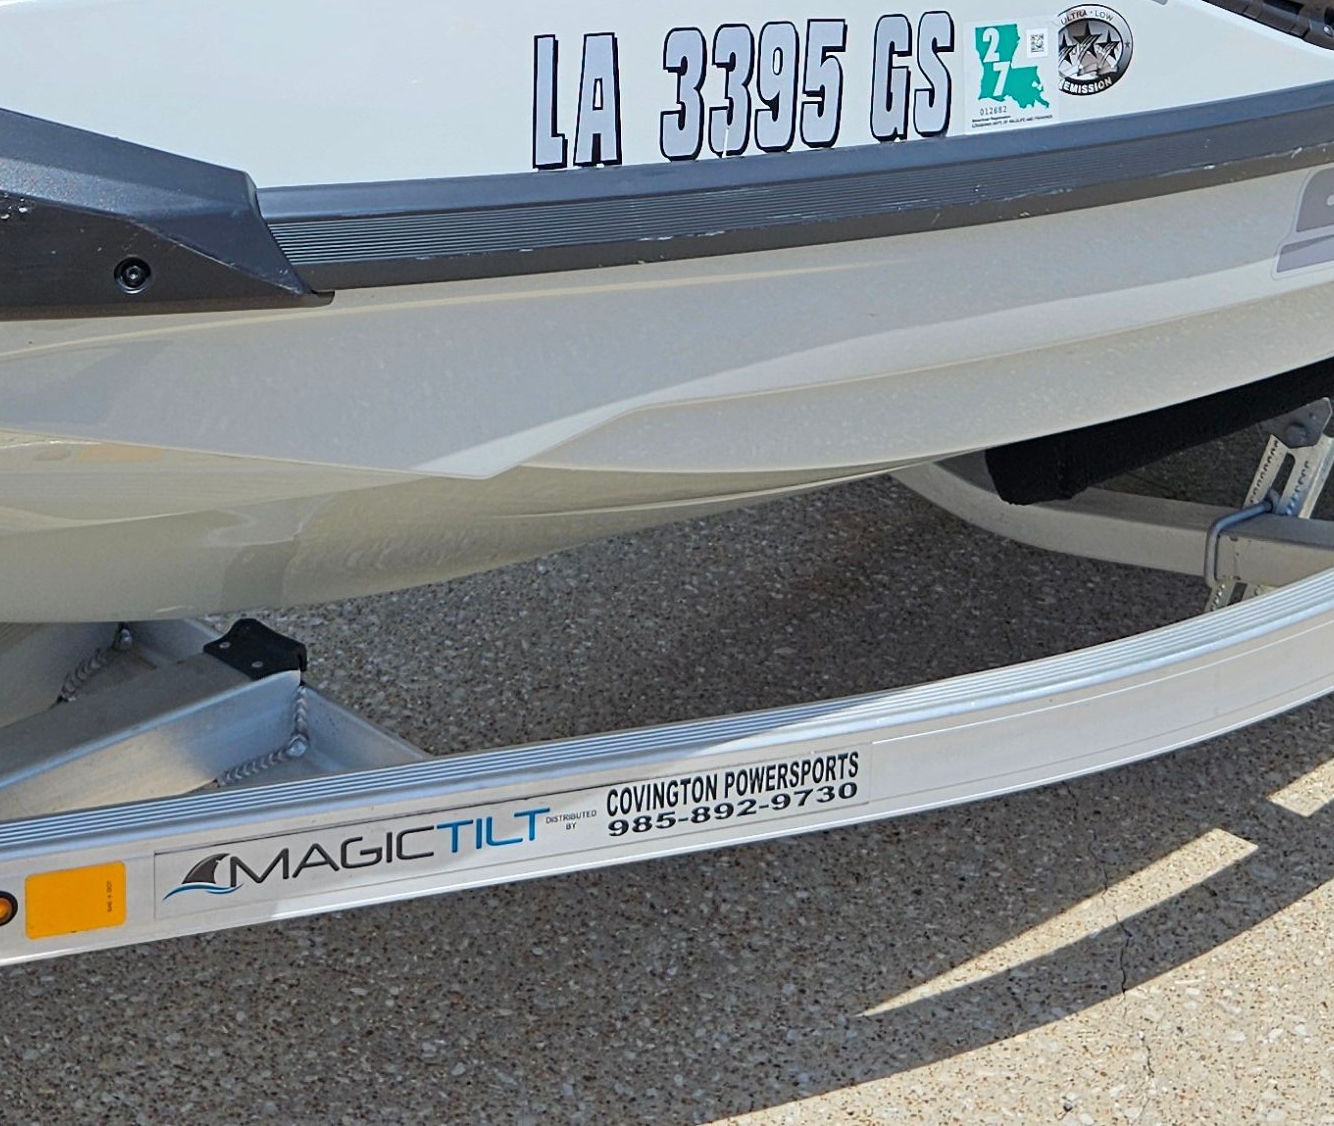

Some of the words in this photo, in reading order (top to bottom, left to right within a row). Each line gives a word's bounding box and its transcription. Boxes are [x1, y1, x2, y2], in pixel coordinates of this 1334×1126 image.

[533, 32, 622, 170] LA
[660, 19, 847, 161] 3395
[870, 10, 955, 142] GS
[1064, 76, 1112, 94] EMISSION
[607, 773, 717, 817] COVINGTON
[724, 751, 859, 798] POWERSPORTS
[608, 781, 858, 837] 985-892-9730
[546, 809, 597, 824] DISTRIBUTED
